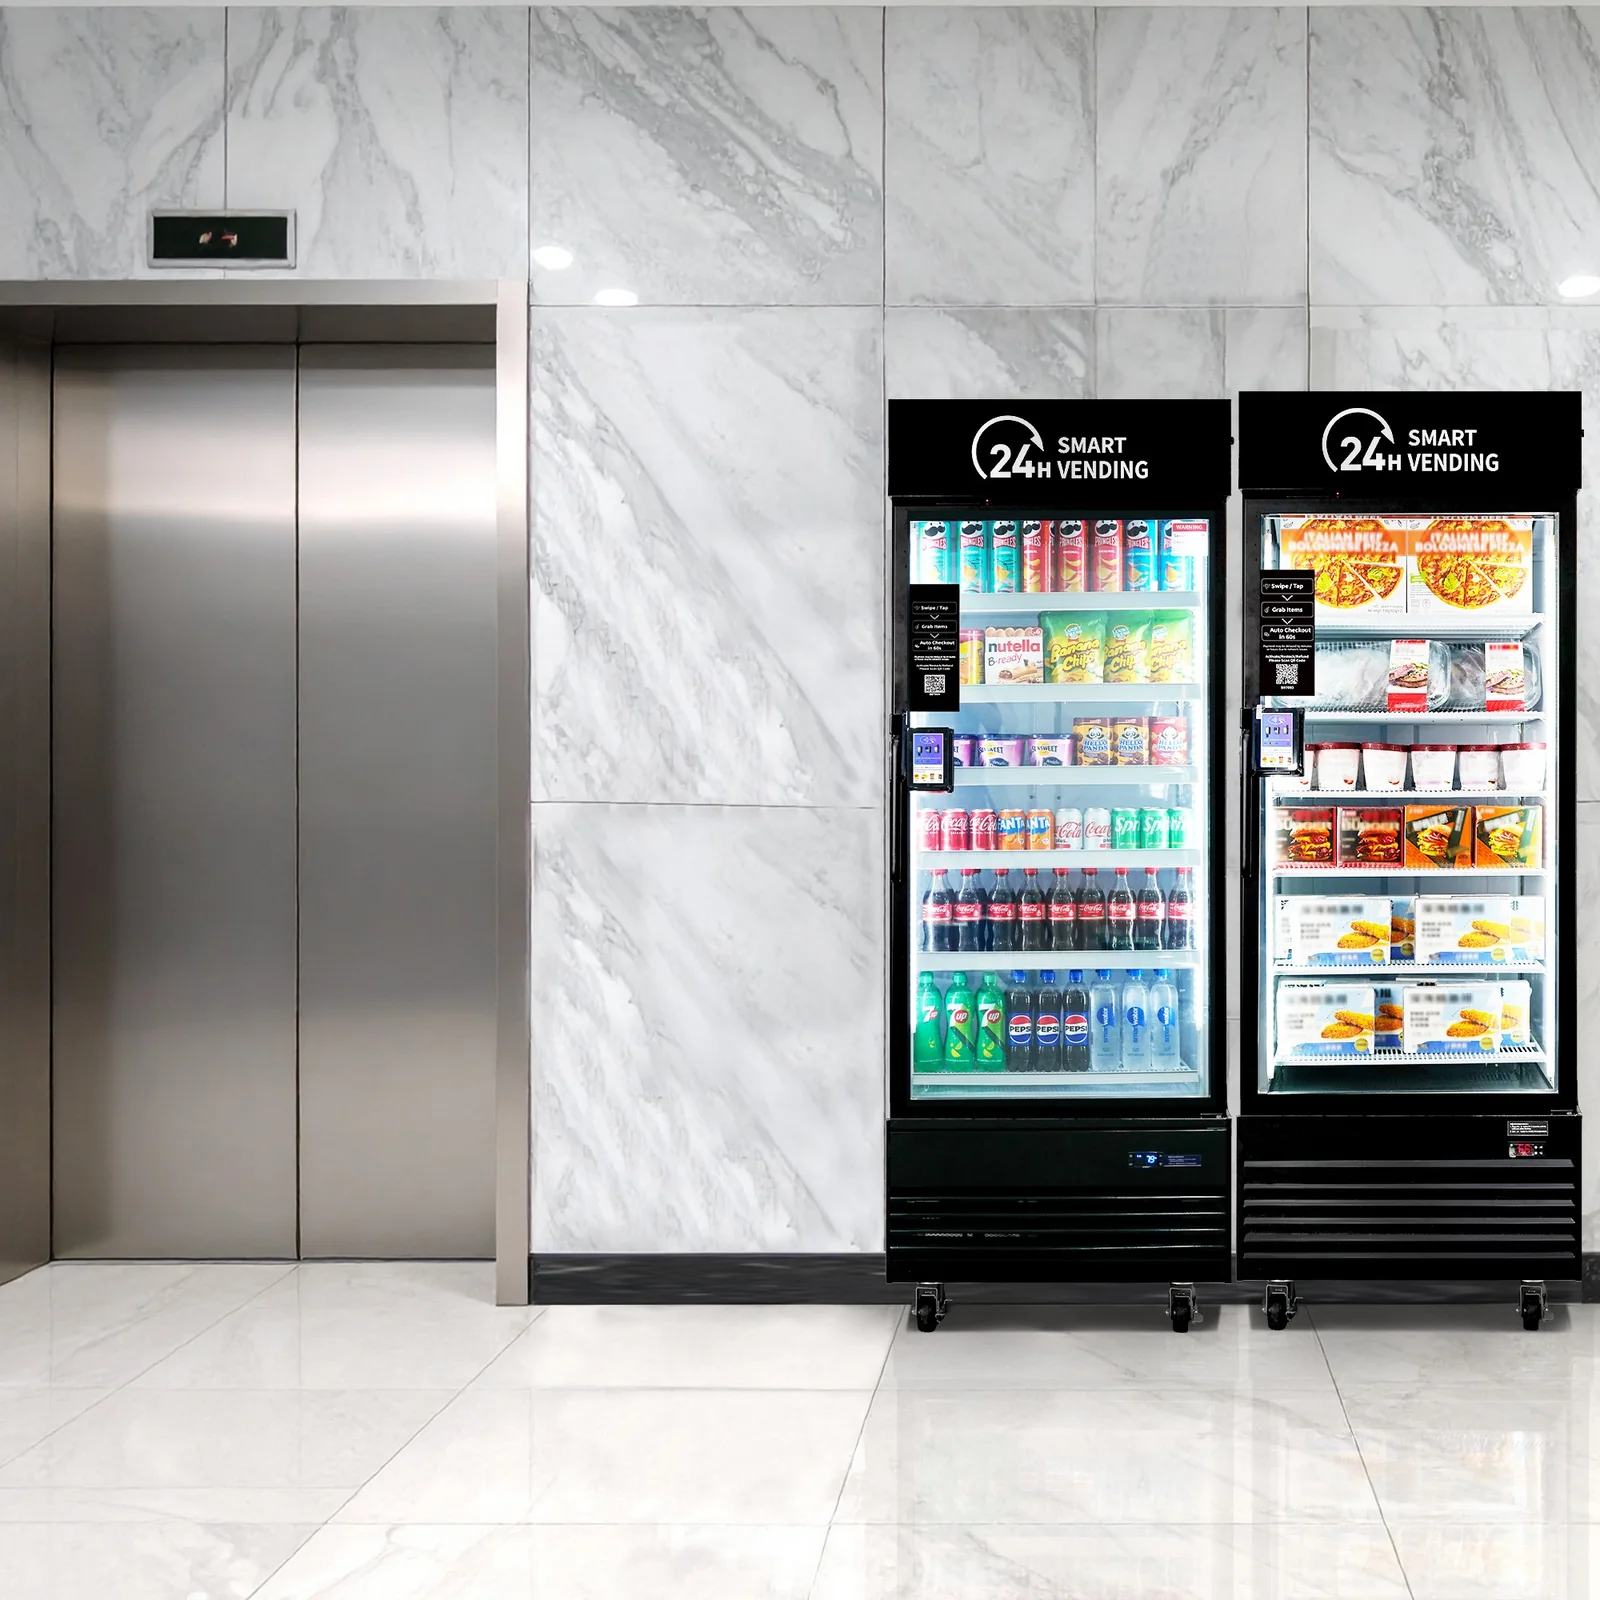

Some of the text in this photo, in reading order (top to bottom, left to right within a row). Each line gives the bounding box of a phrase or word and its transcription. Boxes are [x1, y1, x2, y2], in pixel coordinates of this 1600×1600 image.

[1058, 436, 1127, 454] SMART
[1408, 429, 1477, 446] SMART
[990, 443, 1149, 479] 24H VENDING
[1340, 436, 1499, 472] 24H VENDING
[1304, 532, 1352, 542] ITALIAN
[1430, 532, 1479, 542] ITALIAN
[1363, 542, 1399, 553] PIZZA
[1489, 542, 1524, 553] PIZZA
[988, 639, 1041, 653] nutella
[1050, 639, 1100, 664] Banana
[1062, 651, 1096, 671] Chips
